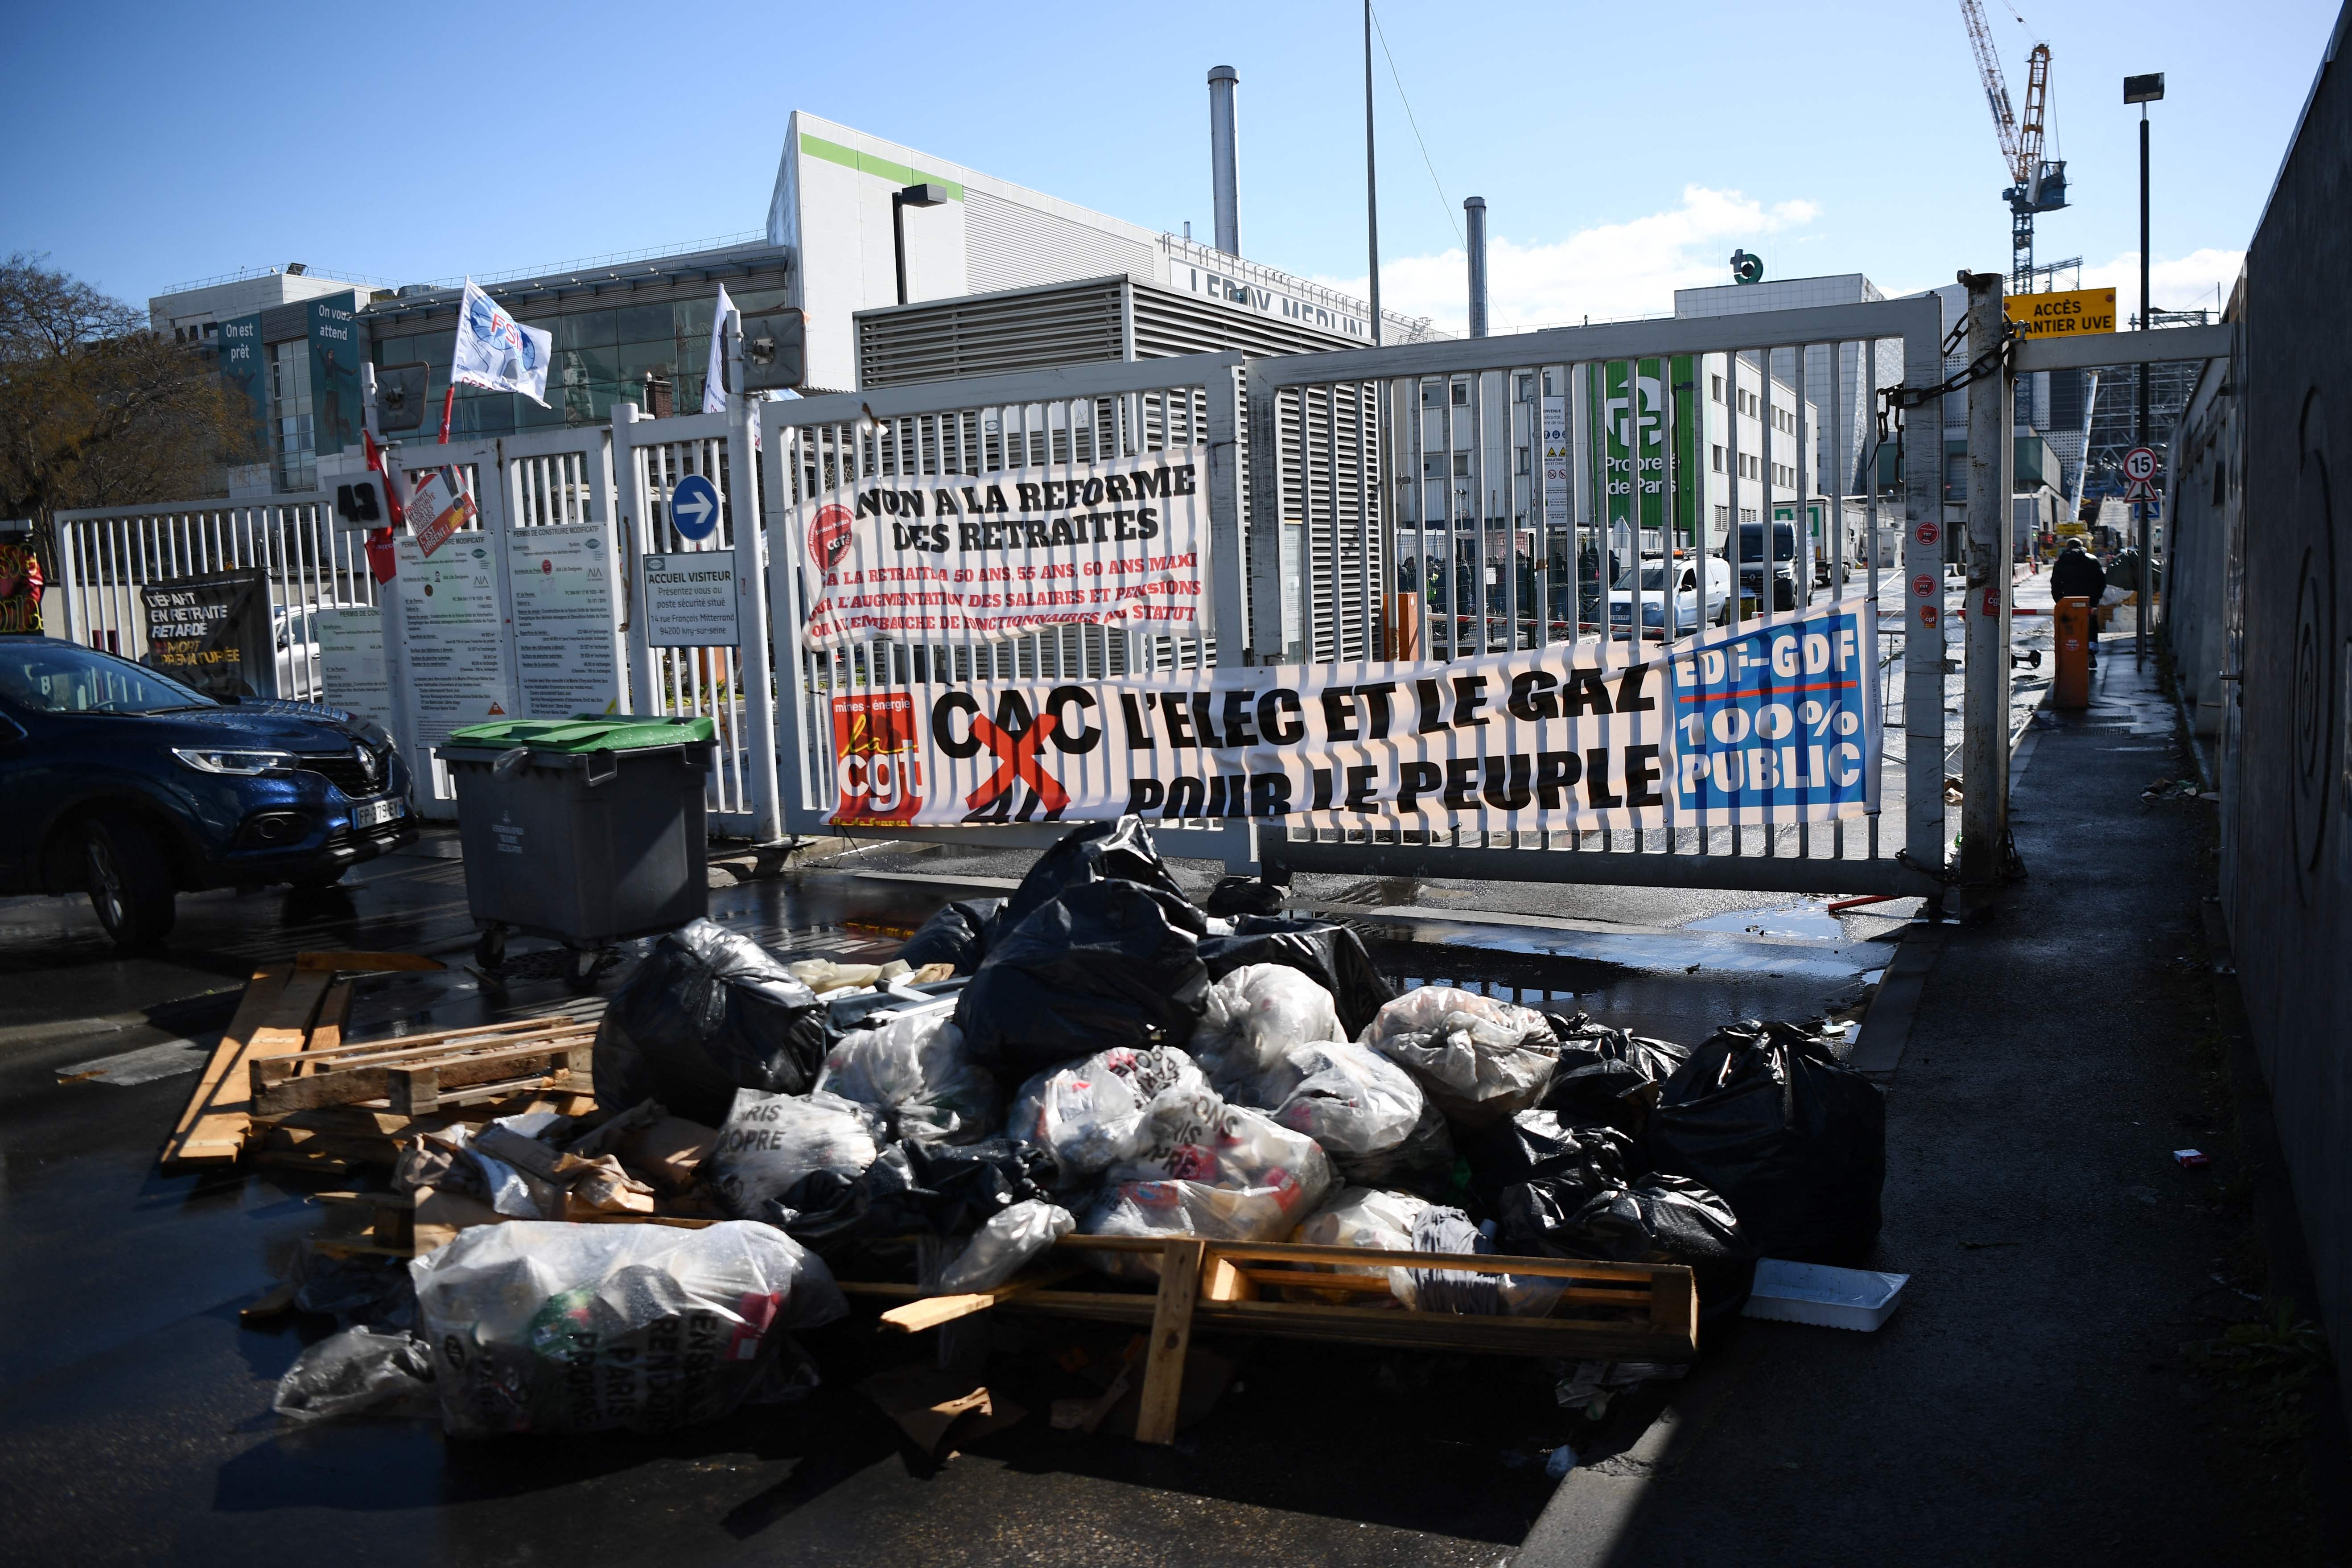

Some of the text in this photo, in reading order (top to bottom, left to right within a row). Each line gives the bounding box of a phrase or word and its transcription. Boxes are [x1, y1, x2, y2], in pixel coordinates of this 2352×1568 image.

[319, 305, 351, 321] On vous
[2034, 299, 2081, 317] ACCÈS
[226, 323, 253, 337] On est
[320, 325, 348, 341] attend
[2023, 316, 2112, 334] ANTIER UVE
[231, 343, 249, 362] prêt
[2130, 457, 2150, 473] 15
[855, 464, 1196, 520] NON A LA REFORME
[1608, 478, 1676, 495] de Pars
[338, 482, 380, 522] 43
[412, 504, 434, 528] POUR LES
[415, 514, 436, 534] USAGERS
[833, 519, 849, 528] Publics
[419, 526, 436, 545] C'EST
[423, 527, 447, 552] URGENT
[539, 528, 569, 536] CONSTRUIRE
[570, 526, 600, 534] MODIFICATIF
[893, 508, 1158, 553] DES RETRAITES
[456, 537, 485, 545] MODIFICATIF
[827, 535, 845, 550] CGT
[649, 571, 731, 584] ACCUEIL VISITEUR
[827, 573, 839, 586] A
[844, 571, 864, 585] LA
[938, 568, 949, 581] A
[954, 569, 974, 582] 50
[979, 567, 1014, 583] ANS,
[1017, 566, 1036, 580] 55
[1041, 563, 1078, 580] ANS,
[1083, 561, 1104, 576] 60
[1108, 558, 1145, 575] ANS
[1149, 552, 1198, 572] MAXI
[146, 592, 196, 607] DÉPART
[659, 587, 692, 597] Présentez
[838, 592, 964, 609] L'AUGMENTATION
[968, 594, 1002, 608] DES
[1006, 589, 1085, 607] SALAIRES
[1090, 588, 1111, 603] ET
[1115, 580, 1201, 601] PENSIONS
[657, 597, 725, 609] poste sécurité situé
[151, 605, 228, 622] EN RETRAITE
[672, 615, 699, 625] François
[700, 613, 735, 622] Mitterrand
[939, 616, 960, 630] DE
[964, 612, 1100, 631] FONCTIONNAIRES
[1104, 609, 1128, 624] AU
[1133, 605, 1196, 622] STATUT
[152, 620, 208, 638] RETARDÉ
[660, 626, 726, 637] 94200 Ivry-sur-seine
[167, 640, 201, 654] MORT
[1675, 629, 1855, 687] EDF-GDF
[835, 701, 865, 713] mines
[873, 697, 911, 713] énergie
[1120, 663, 1655, 749] L'ELEC ET LE GAZ
[932, 685, 1102, 758] CAC
[1679, 700, 1858, 746] 100%
[840, 713, 918, 757] la
[839, 739, 924, 812] cgt
[1681, 742, 1860, 794] PUBLIC
[1124, 744, 1664, 819] POUR LE PEUPLE
